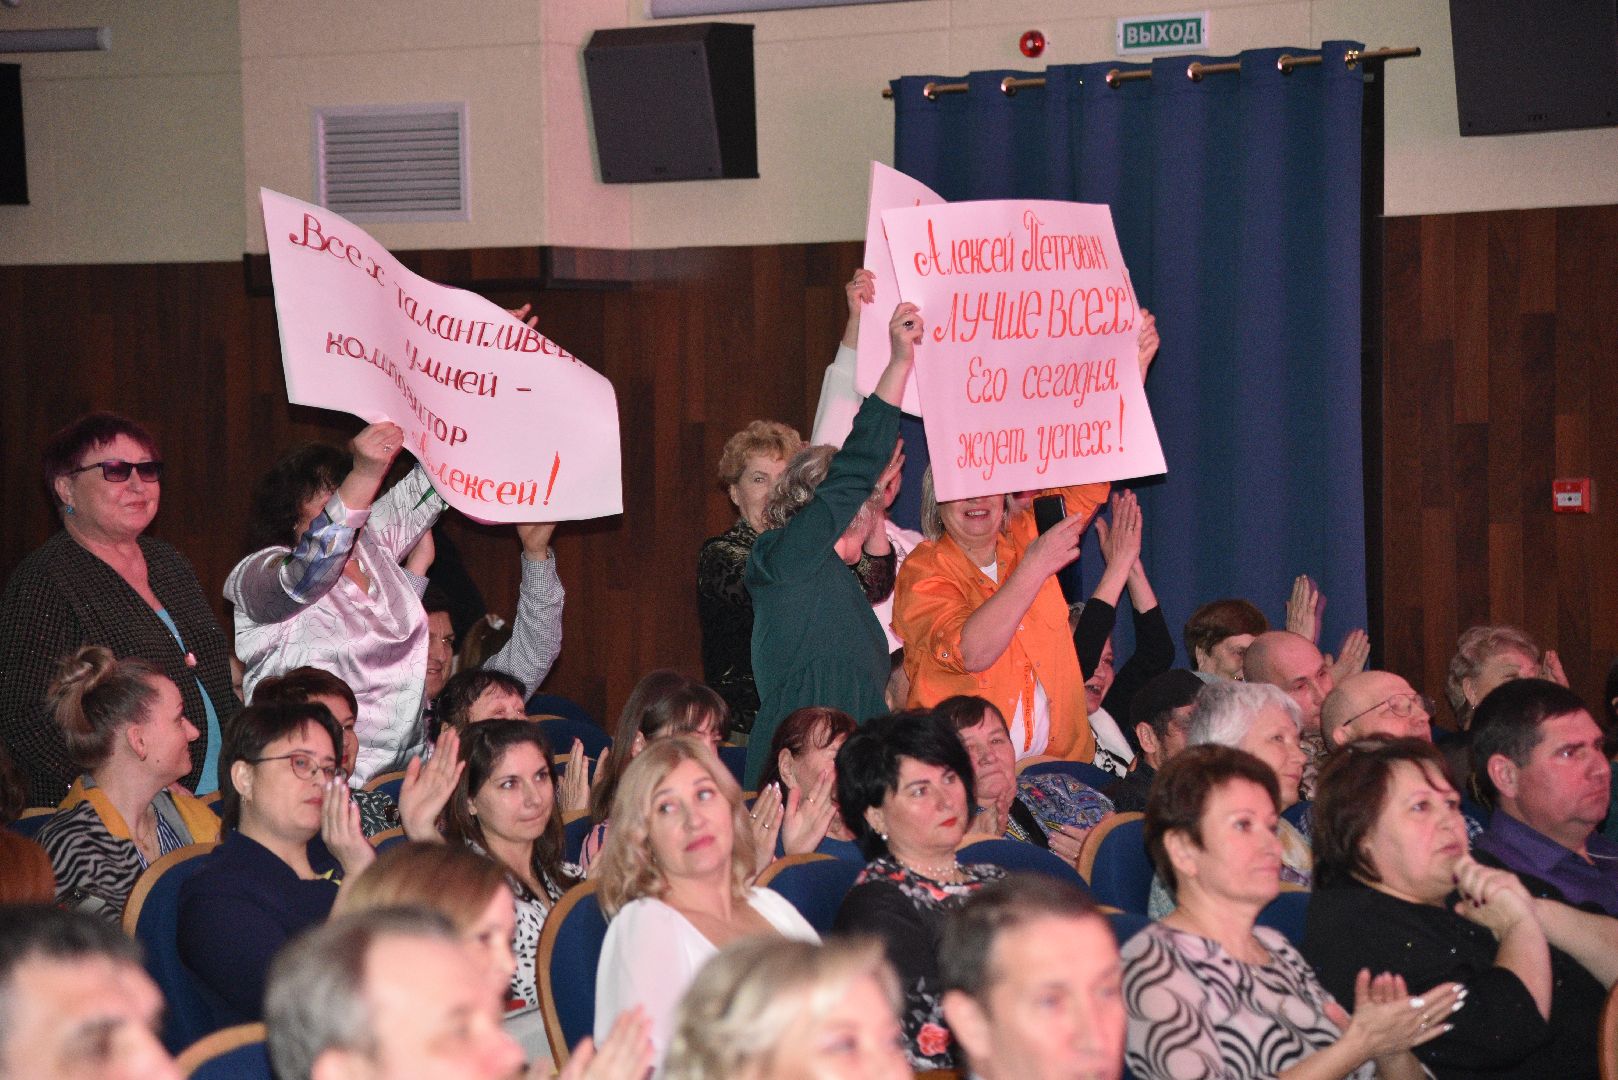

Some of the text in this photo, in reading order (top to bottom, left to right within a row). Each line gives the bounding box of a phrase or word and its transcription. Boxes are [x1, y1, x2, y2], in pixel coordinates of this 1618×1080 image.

[1126, 21, 1198, 45] ВЫХОД
[289, 213, 385, 286] Всех
[914, 209, 1109, 277] Алексей Петрович
[966, 355, 1119, 408] Его сегодня
[956, 429, 1028, 480] ждет
